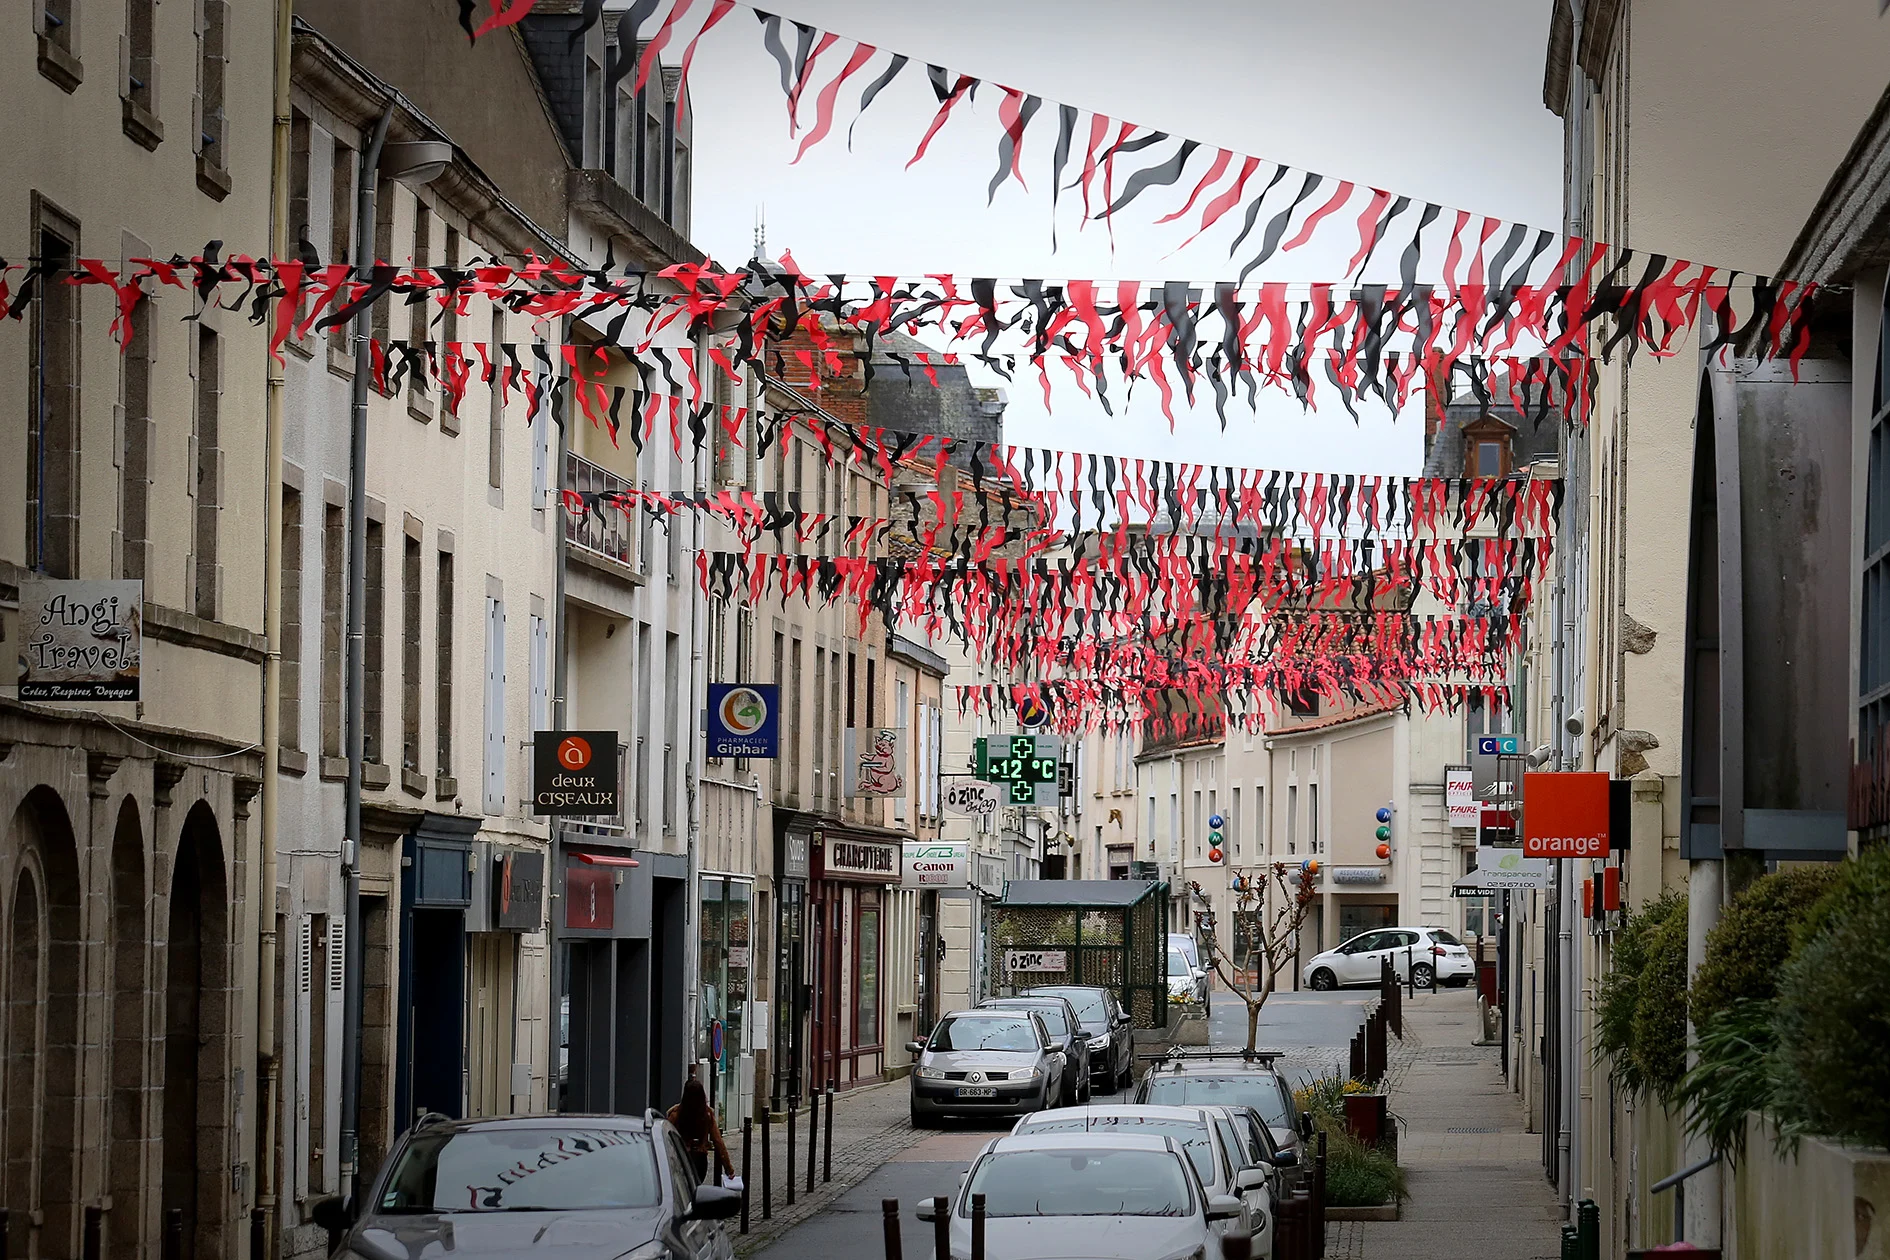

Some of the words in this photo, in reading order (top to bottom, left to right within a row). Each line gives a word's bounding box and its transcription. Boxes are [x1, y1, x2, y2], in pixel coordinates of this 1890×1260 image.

[40, 594, 120, 633] Angi
[29, 633, 132, 670] Travel
[94, 686, 133, 698] Voyager
[564, 740, 584, 764] à
[716, 743, 768, 755] Giphar
[1482, 740, 1514, 752] CIC
[552, 773, 595, 787] deux
[538, 792, 613, 807] CISEAUX
[1450, 806, 1477, 814] FAURE
[1529, 837, 1600, 855] orange
[832, 842, 893, 872] CHARCUTERIE
[913, 861, 955, 872] Canon
[1482, 869, 1542, 878] Transparence
